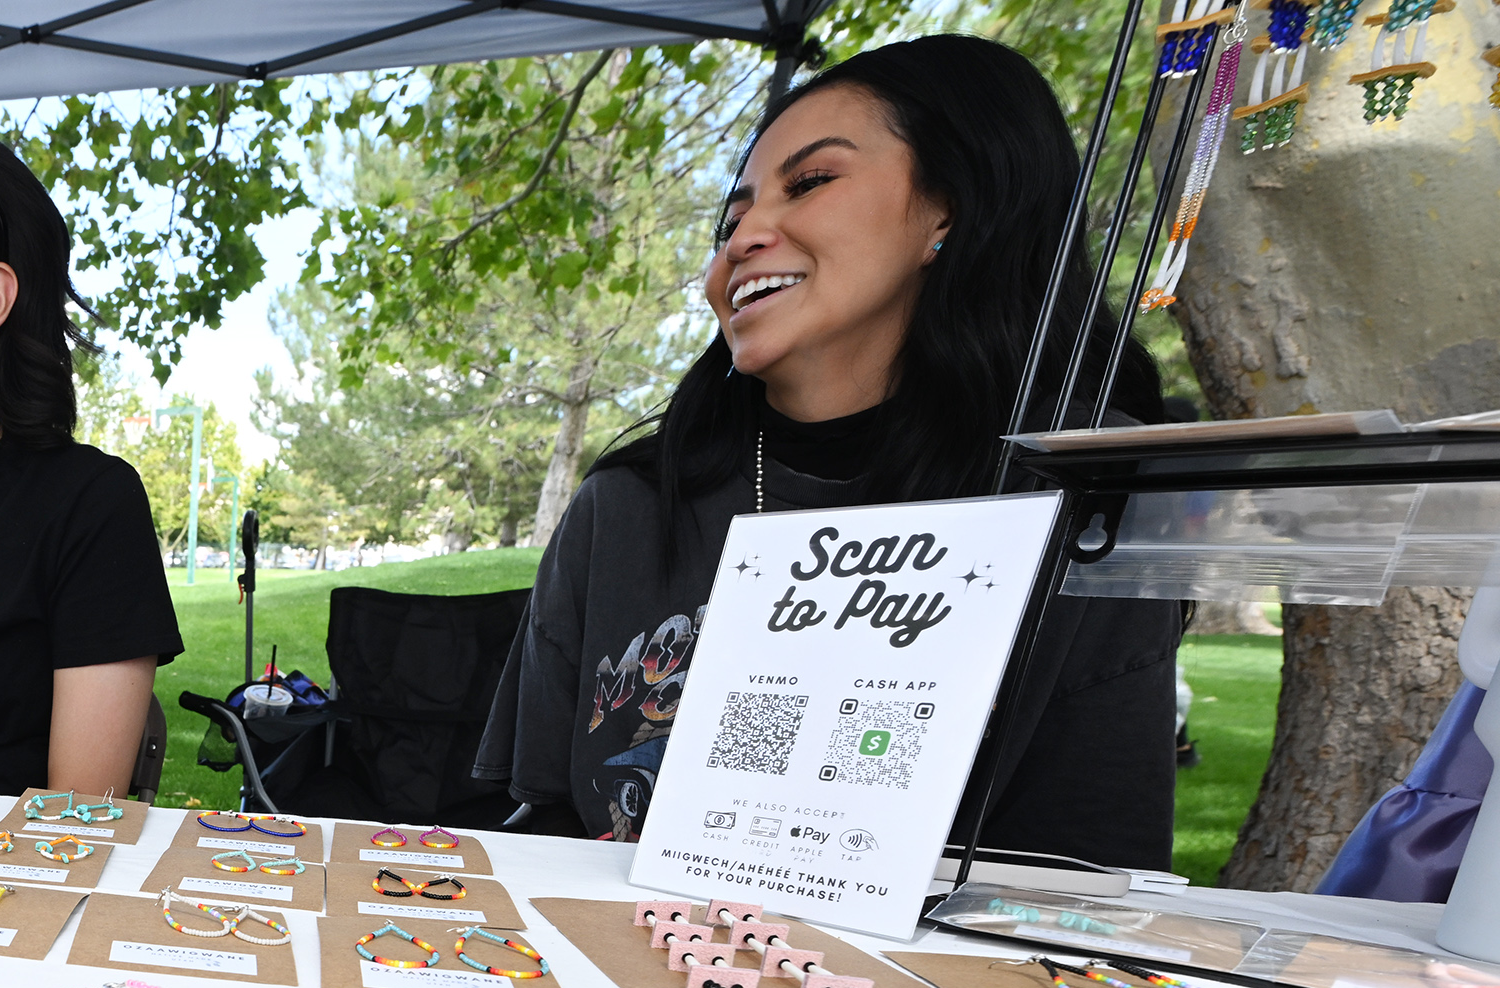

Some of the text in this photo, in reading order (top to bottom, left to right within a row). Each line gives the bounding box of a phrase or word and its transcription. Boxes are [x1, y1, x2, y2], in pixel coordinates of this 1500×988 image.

[790, 526, 949, 581] Scan
[767, 579, 952, 648] to Pay
[748, 674, 799, 686] VENMO
[853, 678, 938, 692] CASH APP
[732, 798, 846, 820] WE ALSO ACCEPT
[702, 831, 730, 842] CASH
[741, 838, 781, 850] CREDIT
[802, 826, 831, 845] Pay
[790, 846, 824, 858] APPLE
[840, 853, 862, 863] TAP
[661, 848, 792, 880] MIIGWECH/AHÉHÉÉ
[797, 872, 847, 889] THANK
[855, 882, 889, 897] YOU
[685, 866, 843, 903] FOR YOUR PURCHASE!
[370, 966, 504, 985] OZAAWIGWANE
